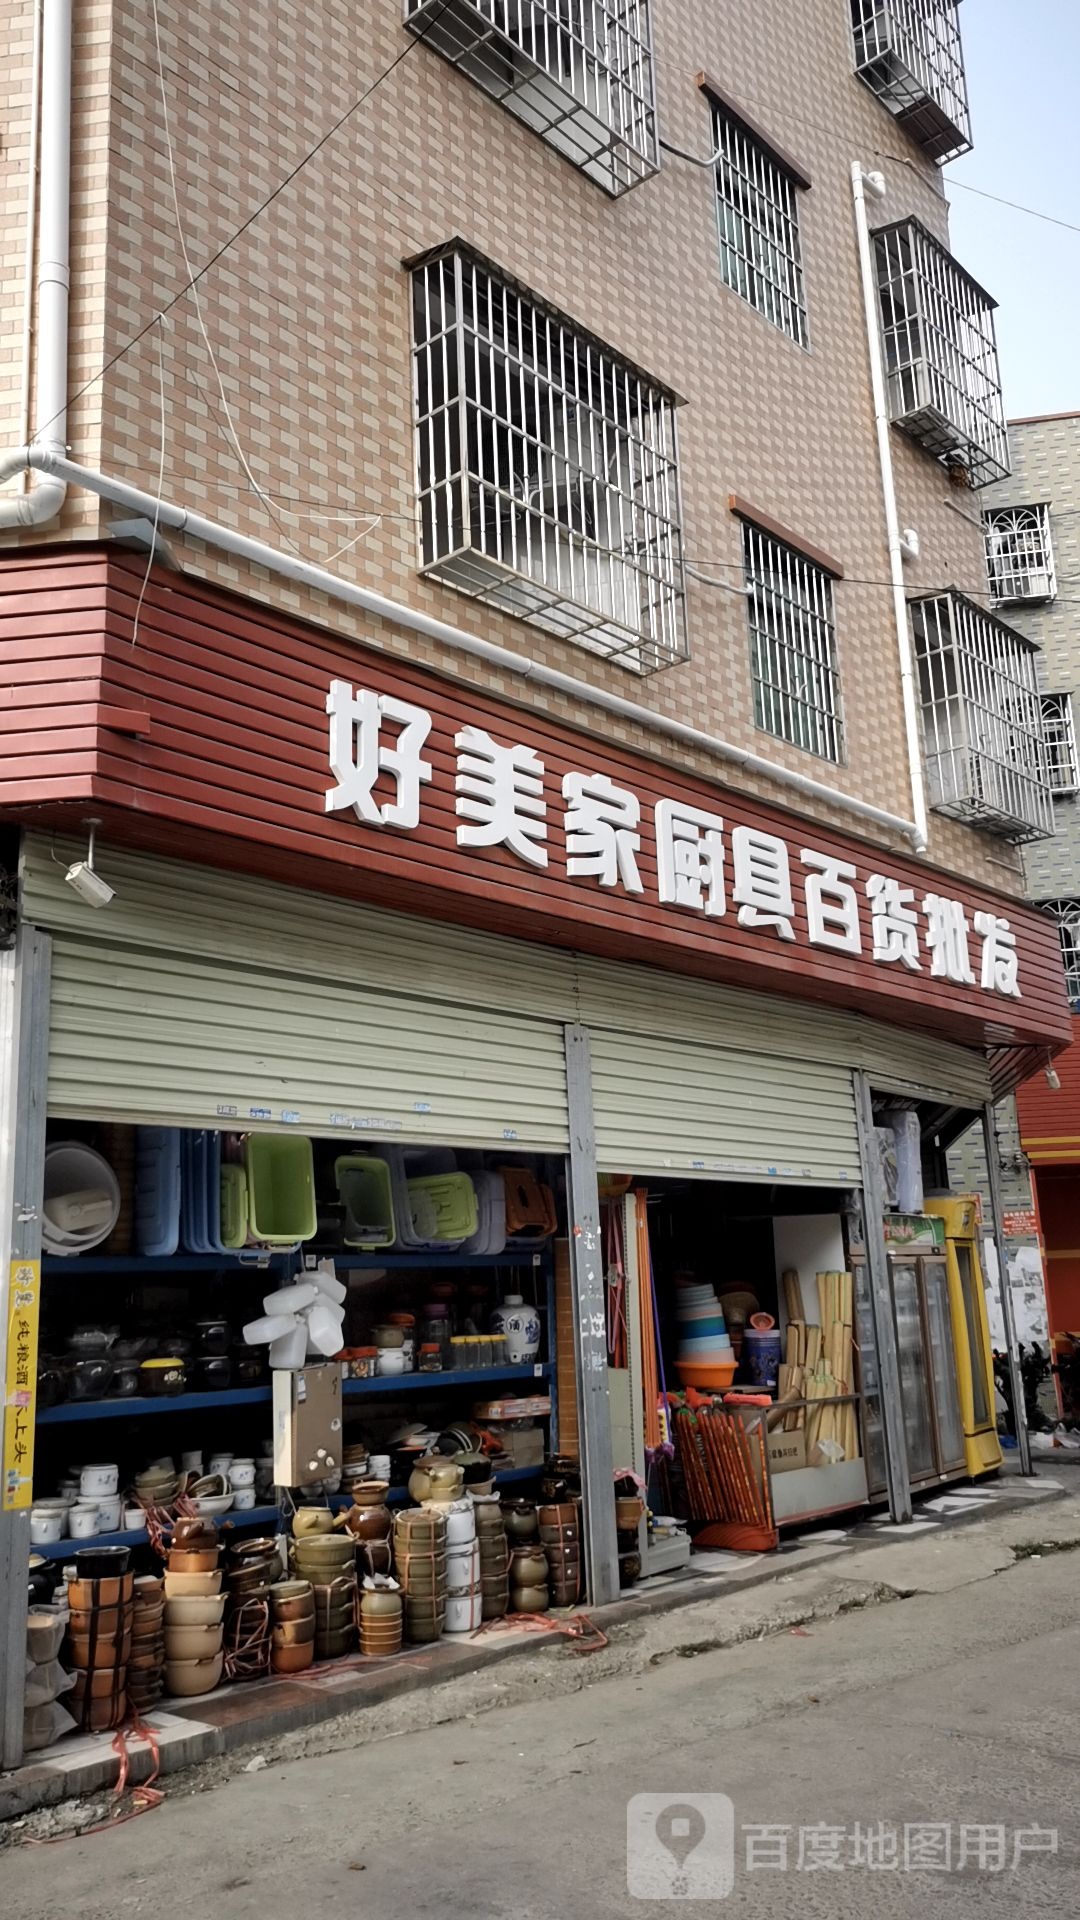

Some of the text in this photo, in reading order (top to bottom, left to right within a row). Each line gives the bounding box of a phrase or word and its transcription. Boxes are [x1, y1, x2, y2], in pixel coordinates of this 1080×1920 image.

[324, 679, 1022, 999] 好美家厨具百货批发
